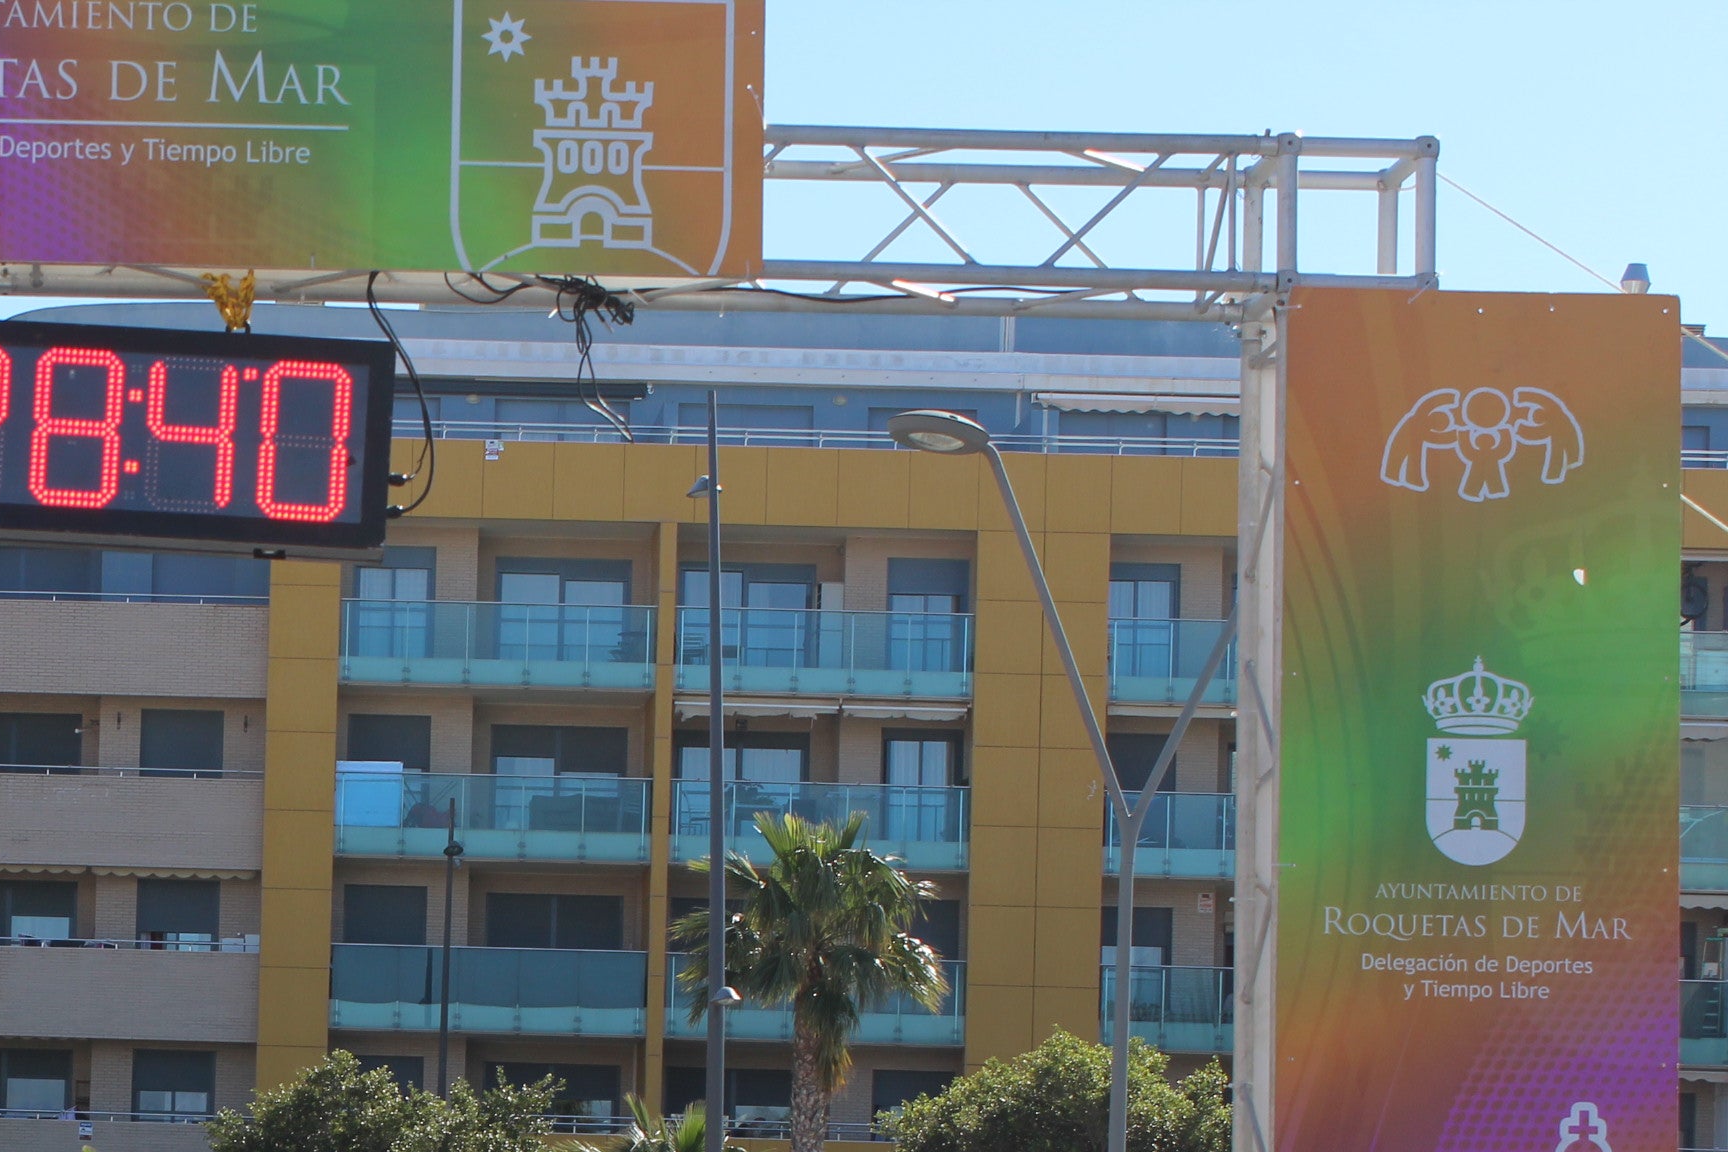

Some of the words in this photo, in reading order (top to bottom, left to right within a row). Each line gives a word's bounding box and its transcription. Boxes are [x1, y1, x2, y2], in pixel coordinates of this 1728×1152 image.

[209, 3, 257, 33] DE
[108, 59, 178, 102] DE
[205, 49, 352, 106] MAR
[120, 143, 136, 166] y
[142, 138, 237, 168] Tiempo
[246, 141, 311, 164] Libre
[1374, 883, 1548, 902] AYUNTAMIENTO
[1555, 885, 1583, 903] DE
[1323, 906, 1487, 941] ROQUETAS
[1501, 916, 1540, 939] DE
[1554, 910, 1633, 940] MAR
[1360, 952, 1468, 975] Delegación
[1474, 955, 1499, 973] de
[1505, 956, 1594, 977] Deportes
[1403, 983, 1415, 1000] y
[1420, 979, 1493, 1002] Tiempo
[1499, 981, 1551, 999] Libre
